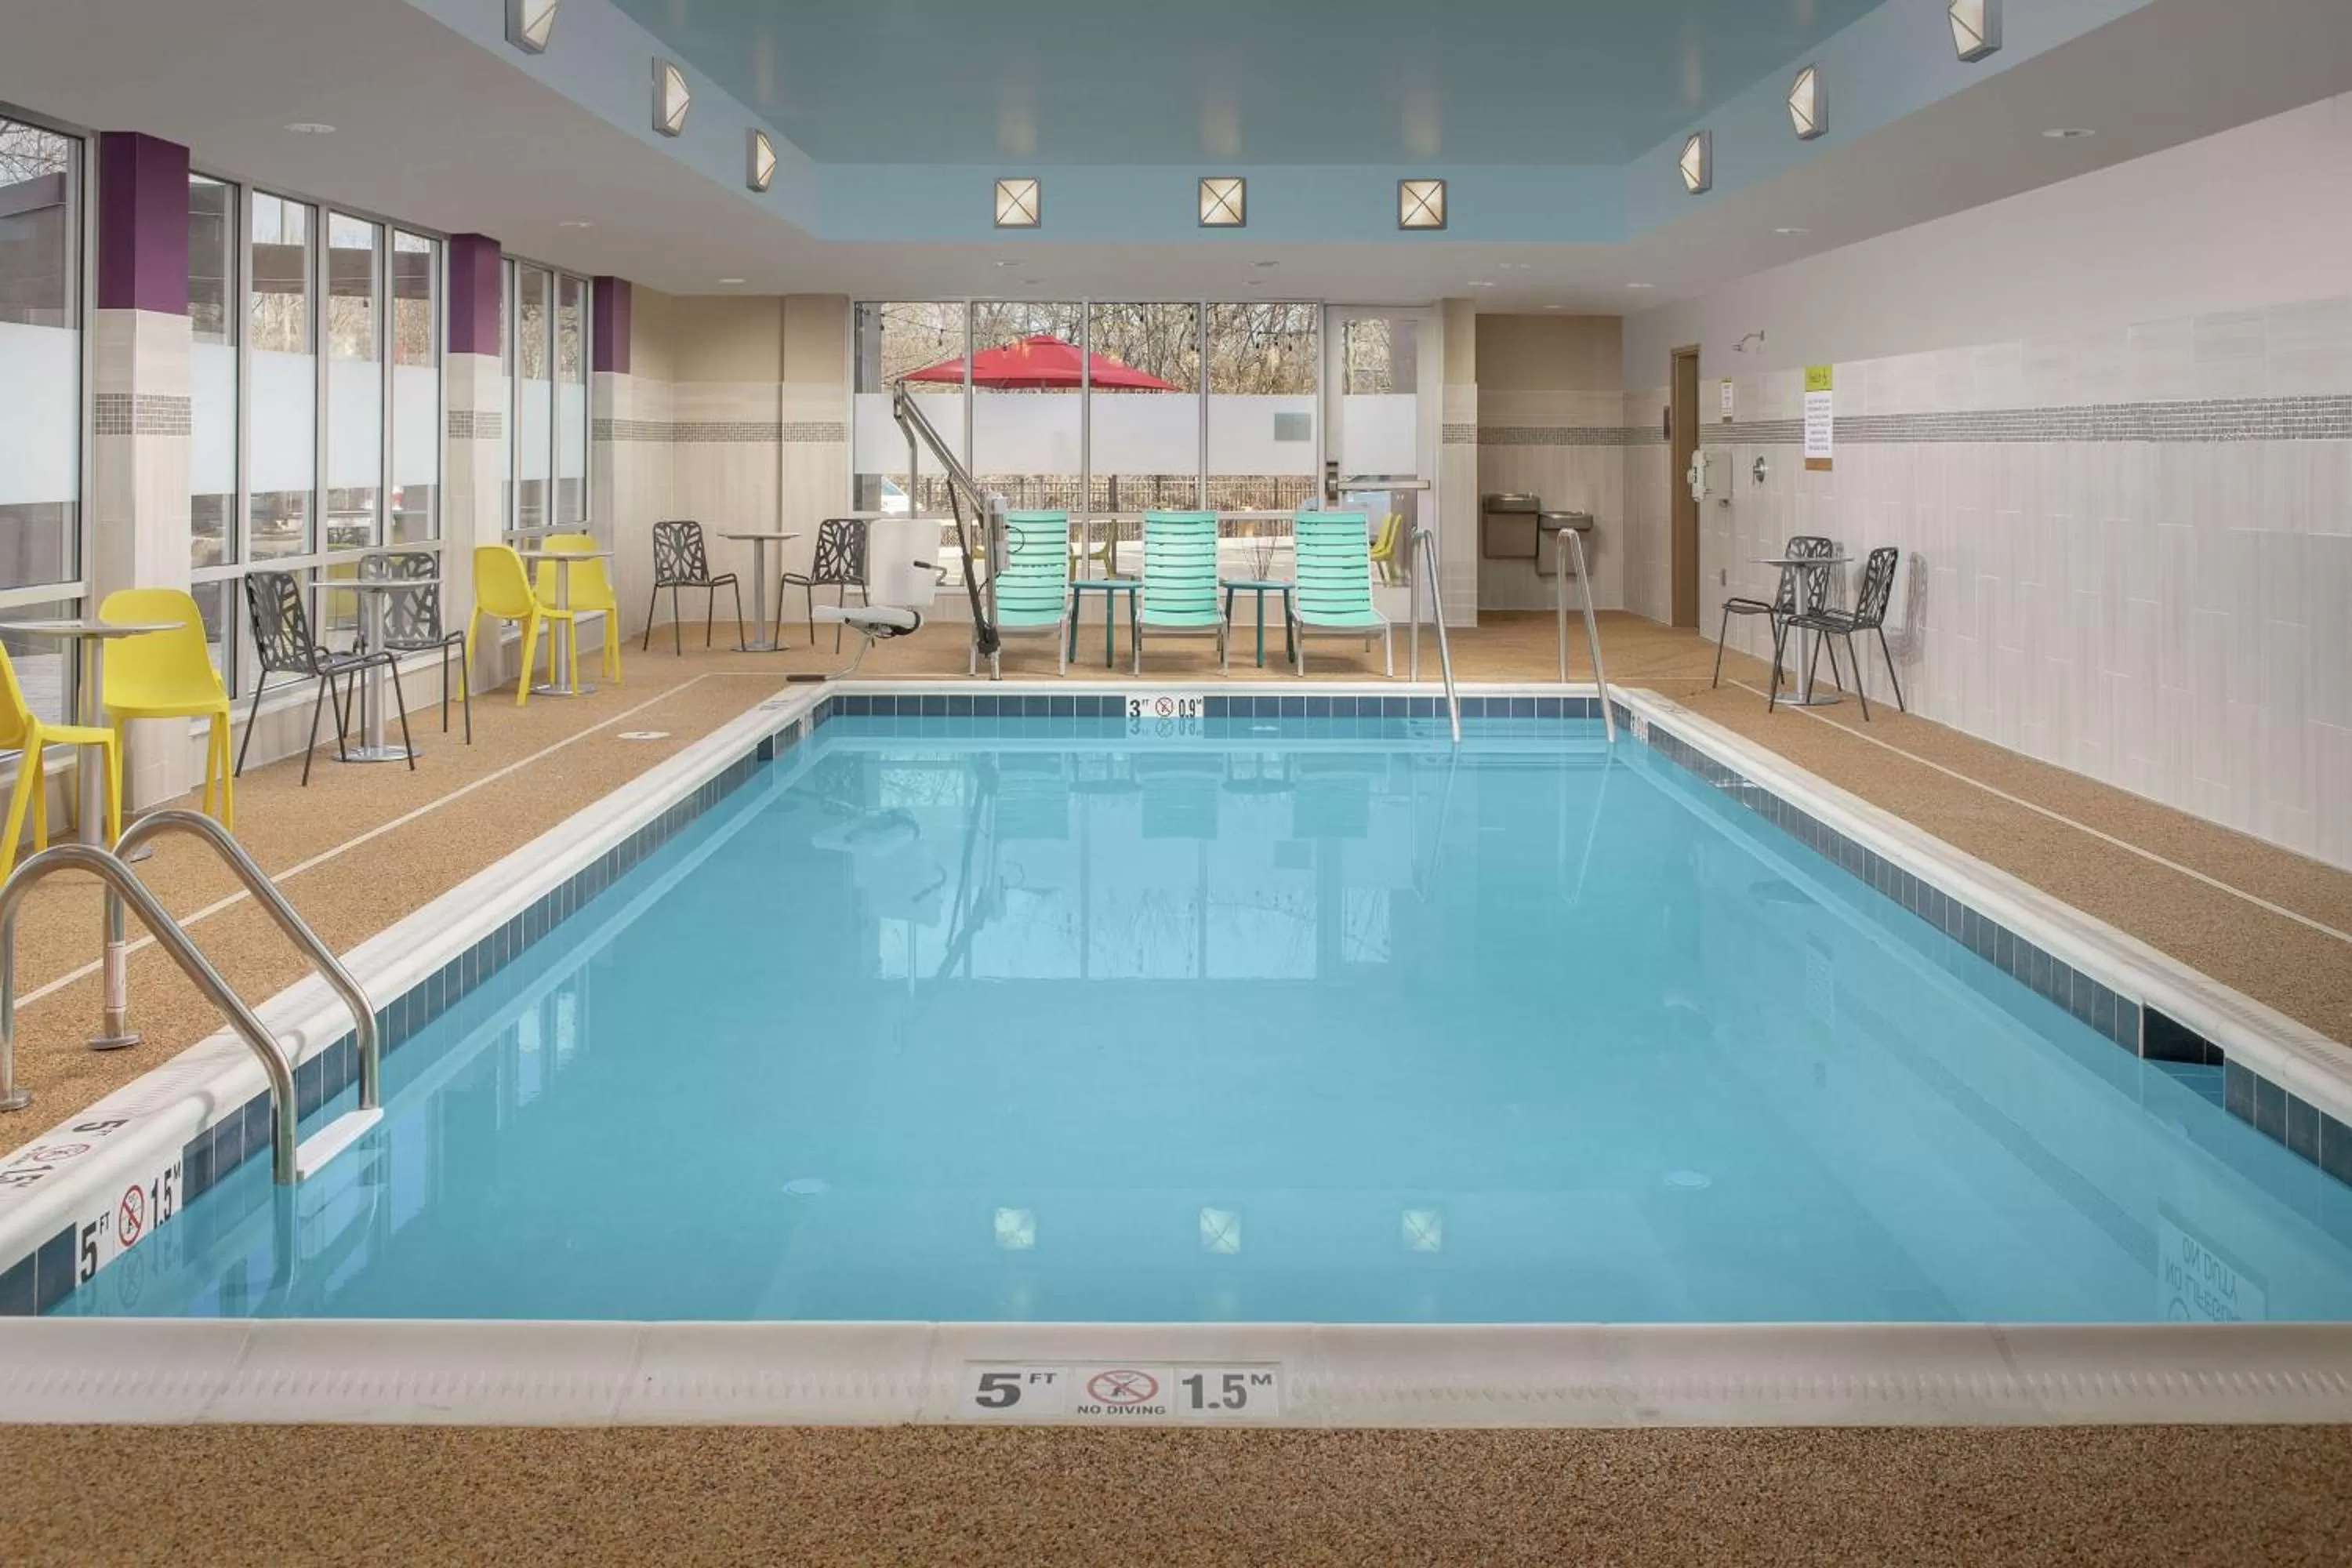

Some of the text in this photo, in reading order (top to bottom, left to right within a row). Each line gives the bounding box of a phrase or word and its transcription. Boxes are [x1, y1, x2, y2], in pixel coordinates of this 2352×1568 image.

[1129, 699, 1141, 718] 3
[1178, 699, 1196, 719] 0.9
[81, 1161, 181, 1283] 5 FT 1.5 M
[975, 1373, 1272, 1410] 5 FT 1.5 M
[1077, 1405, 1167, 1416] NO DIVING
